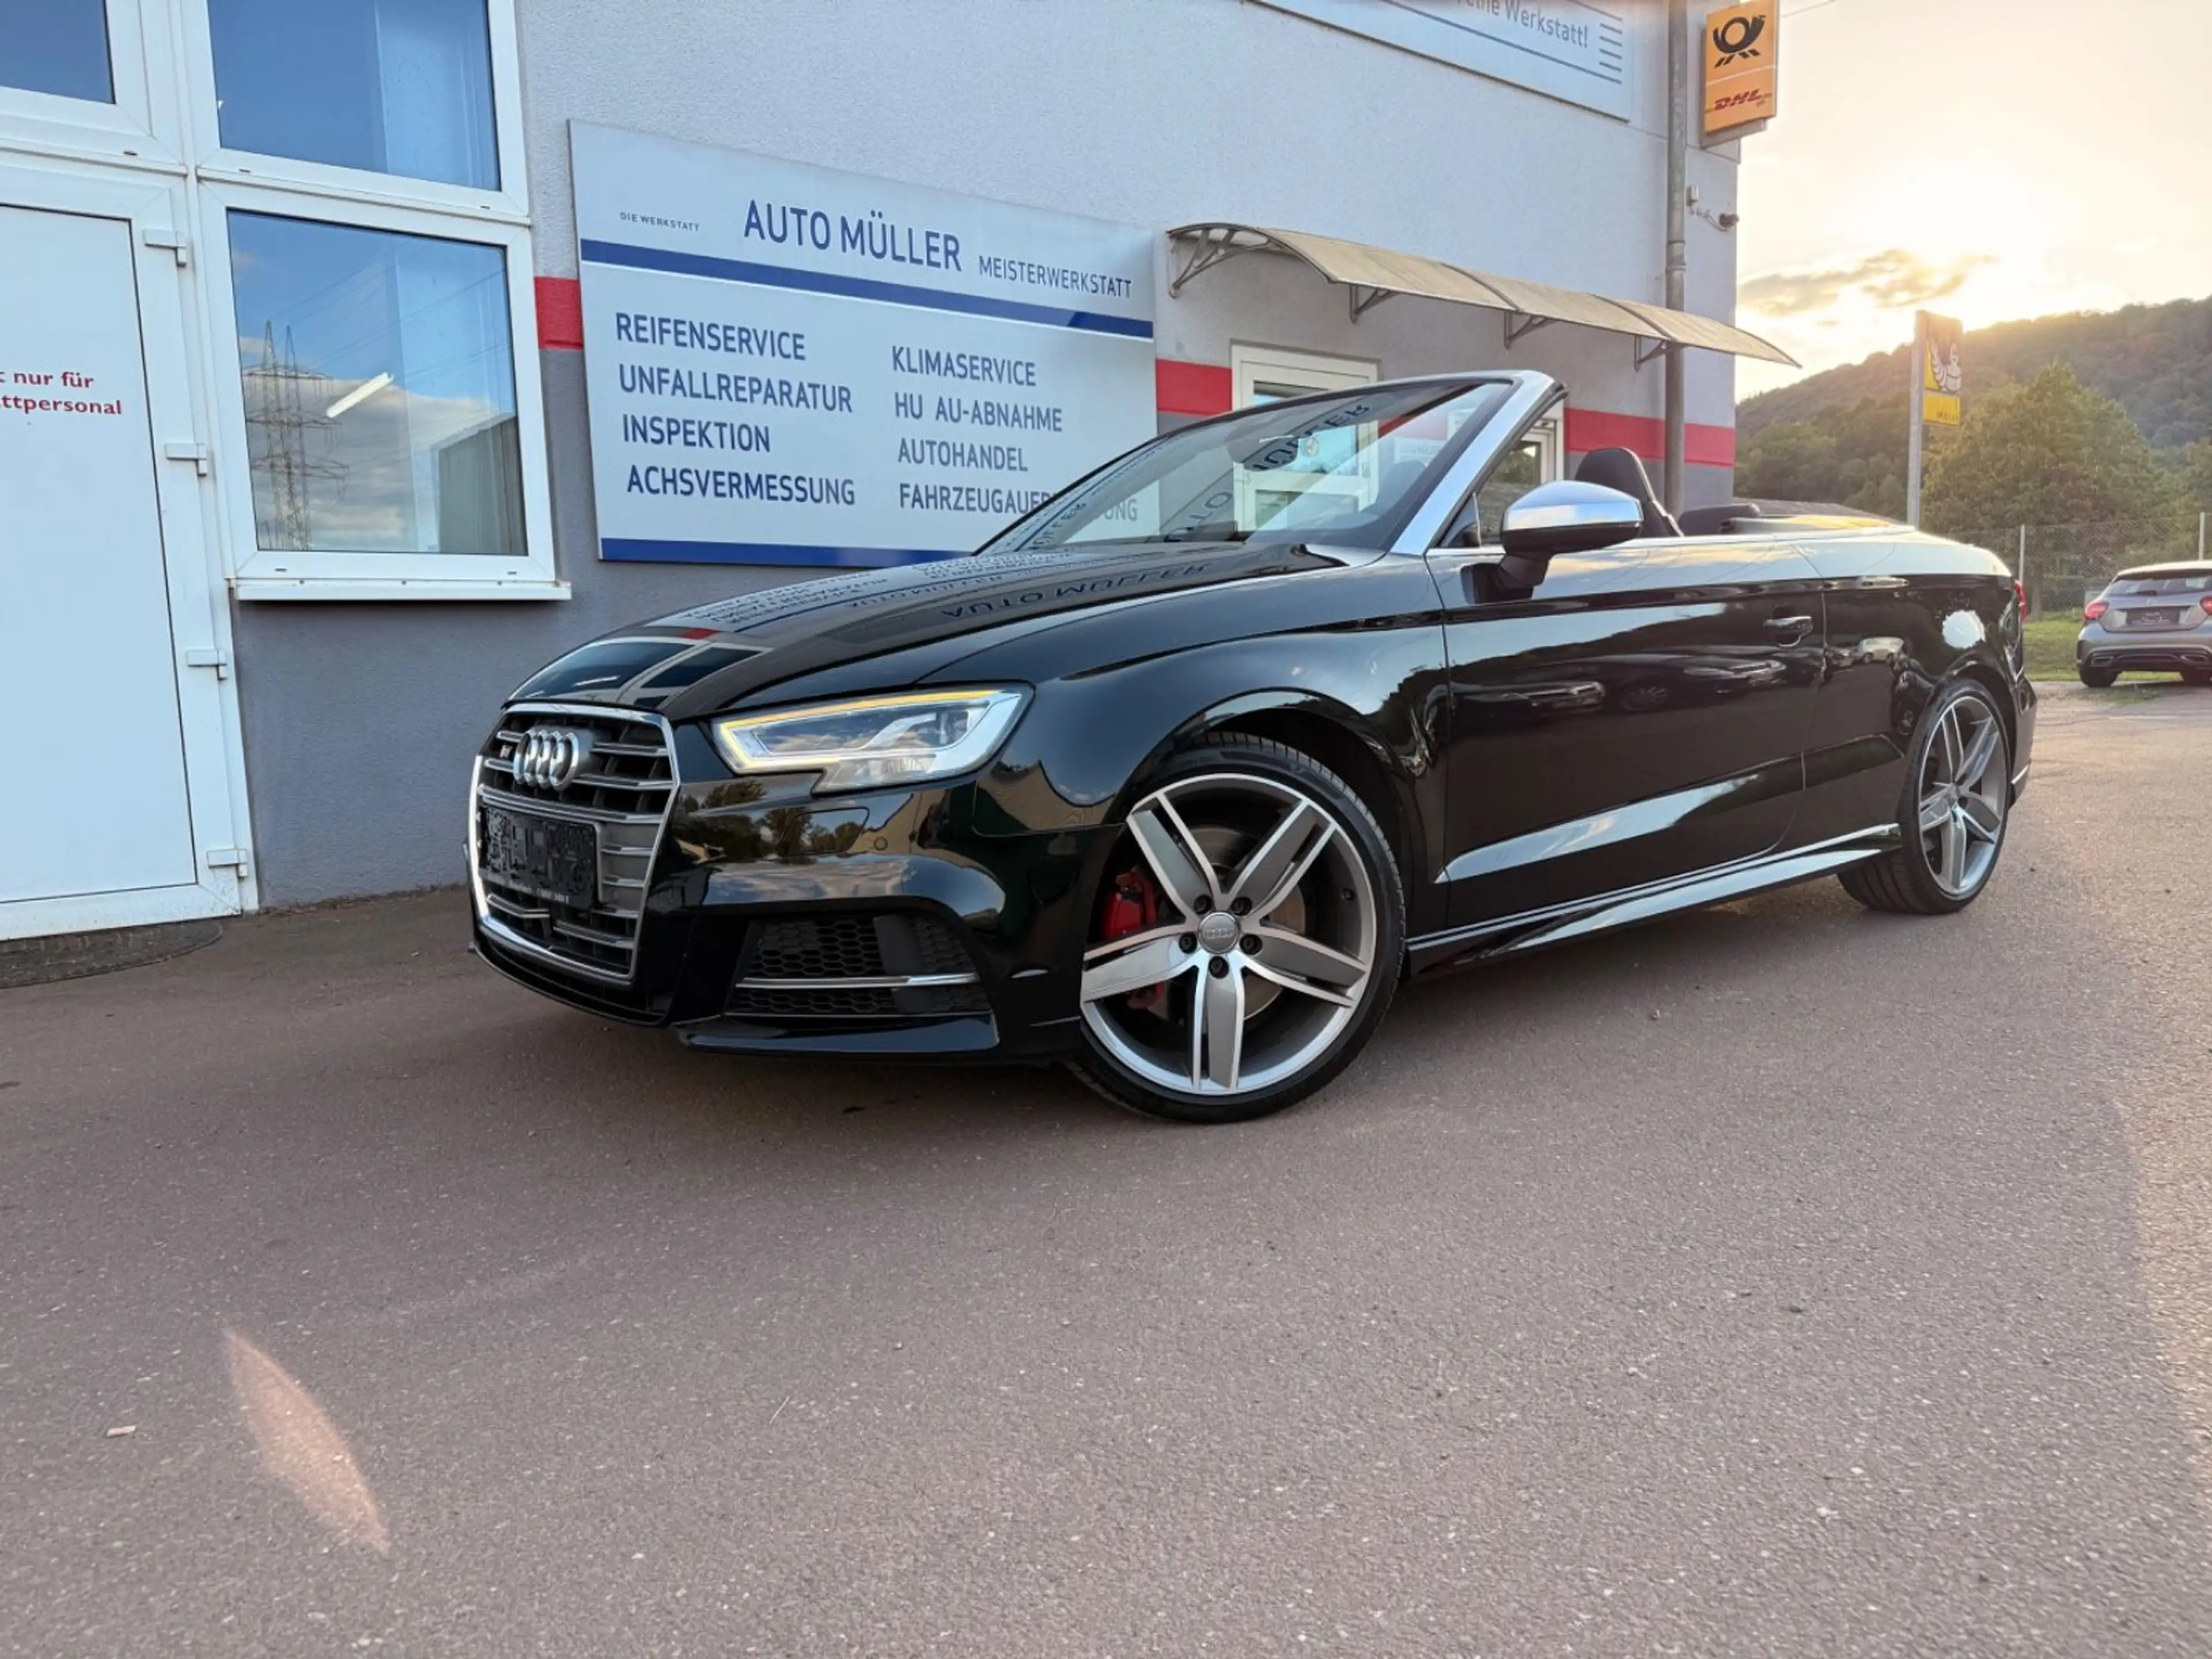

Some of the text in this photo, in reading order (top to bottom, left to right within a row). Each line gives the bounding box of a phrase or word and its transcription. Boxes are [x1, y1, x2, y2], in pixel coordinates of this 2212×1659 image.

[1714, 88, 1763, 111] DHL
[639, 215, 699, 232] WERKSTATT
[743, 199, 962, 271] AUTO MÜLLER
[978, 255, 1132, 300] MEISTERWERKSTATT
[615, 312, 806, 361] REIFENSERVICE
[13, 372, 54, 385] nur
[61, 371, 94, 388] für
[892, 346, 1037, 387] KLIMASERVICE
[619, 363, 853, 414] UNFALLREPARATUR
[894, 392, 1063, 433] HU AU-ABNAHME
[623, 414, 771, 453] INSPEKTION
[897, 438, 1029, 472] AUTOHANDEL
[626, 464, 855, 506] ACHSVERMESSUNG
